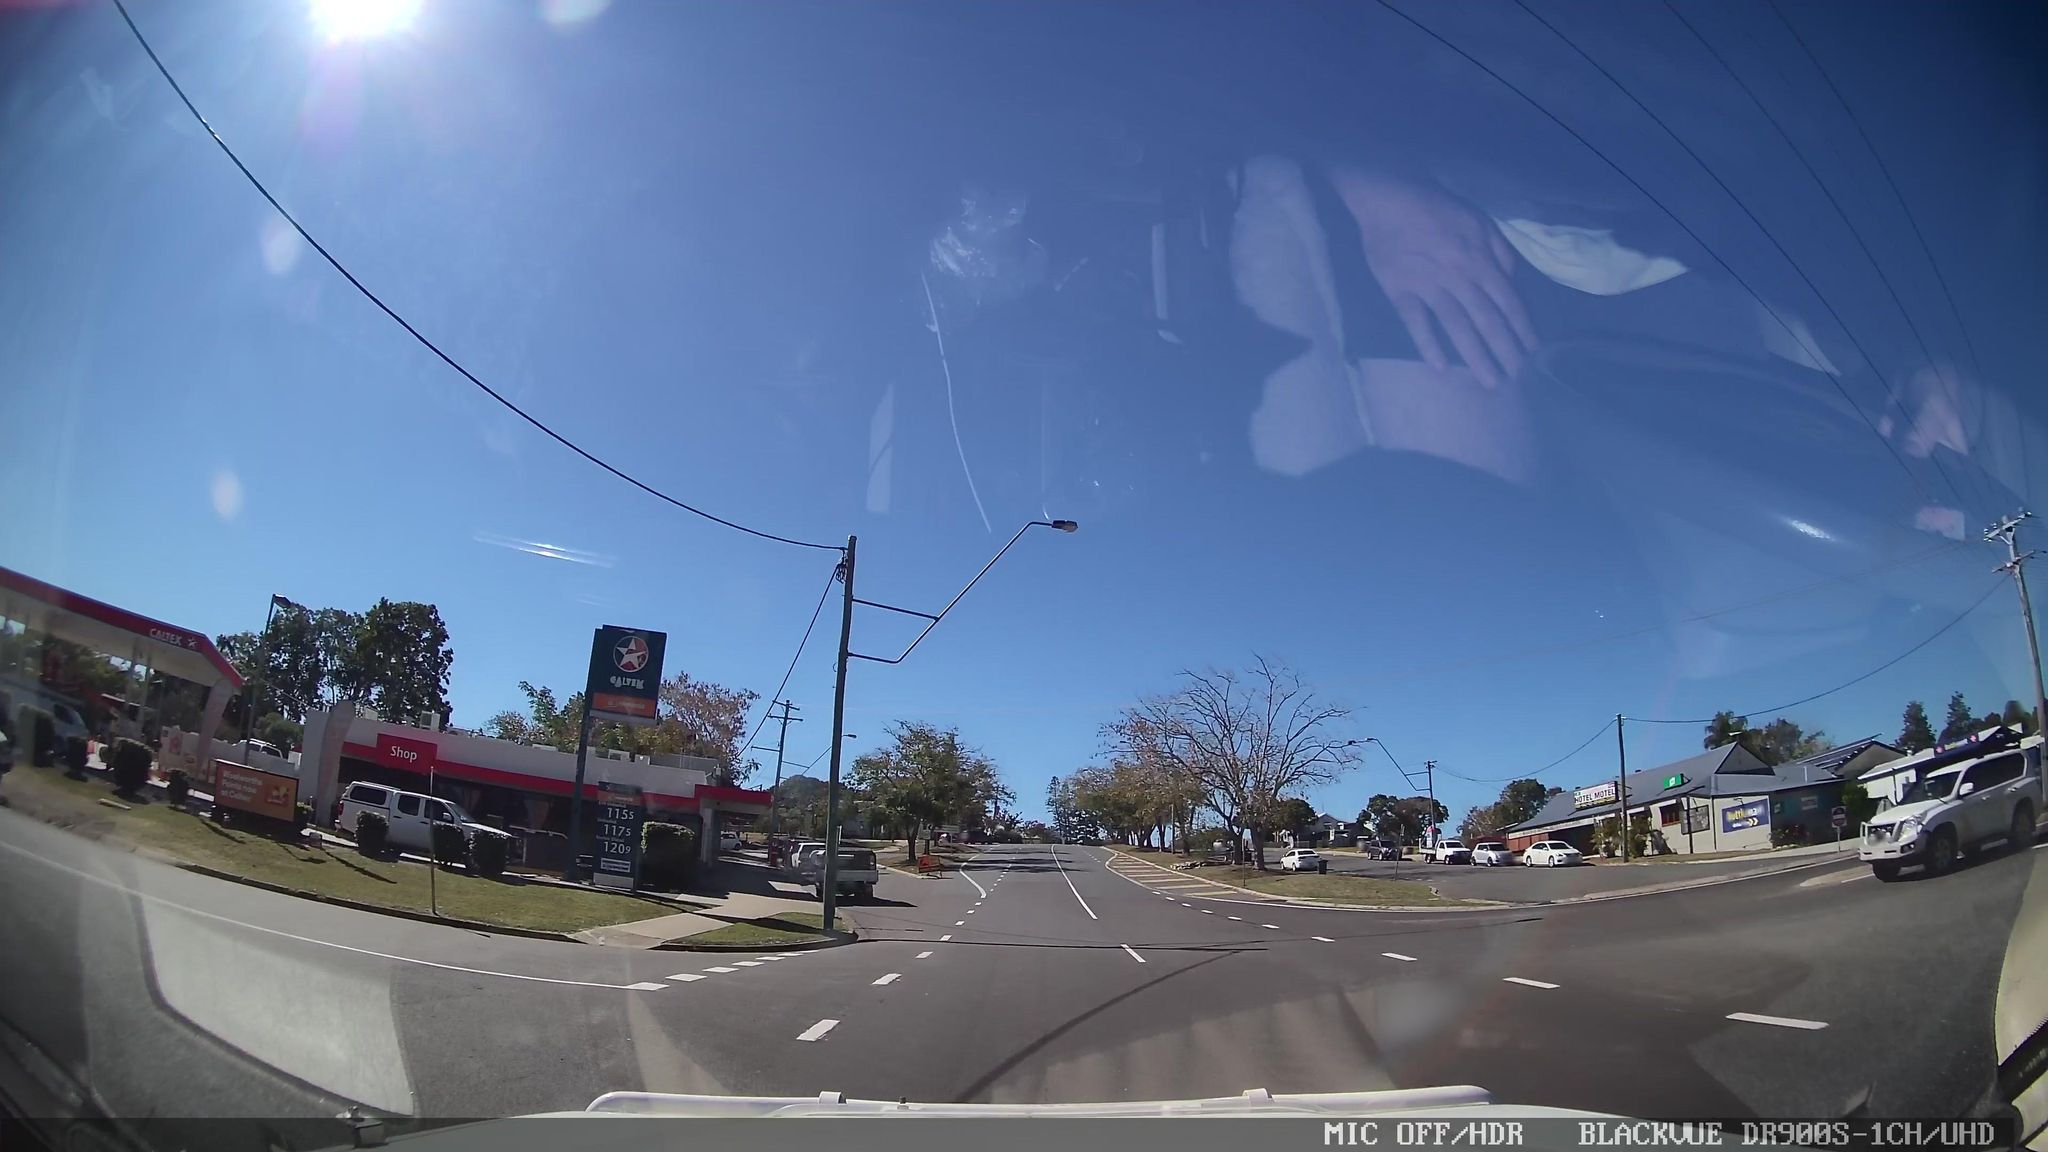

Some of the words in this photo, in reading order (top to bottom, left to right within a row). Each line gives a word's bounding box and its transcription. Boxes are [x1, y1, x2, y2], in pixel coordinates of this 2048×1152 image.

[150, 628, 182, 646] CALTEX
[390, 745, 418, 763] Shop
[1574, 793, 1593, 804] HOTEL
[1594, 788, 1615, 799] MOTEL
